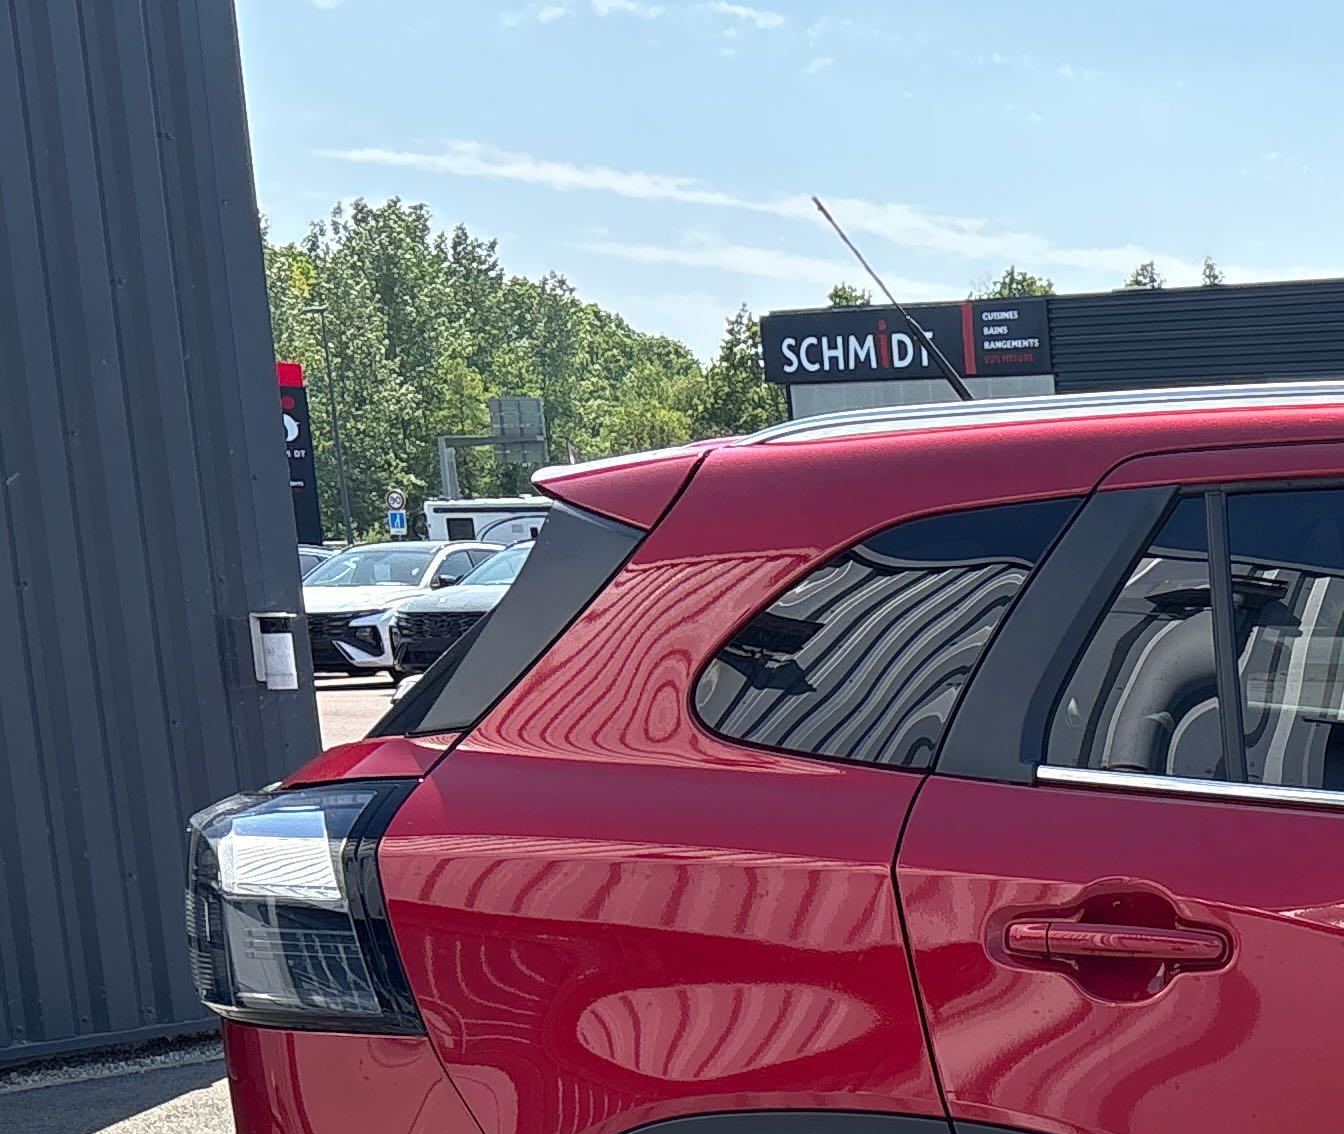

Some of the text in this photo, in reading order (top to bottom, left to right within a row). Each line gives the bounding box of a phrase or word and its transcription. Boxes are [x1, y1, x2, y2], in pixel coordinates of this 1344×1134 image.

[982, 310, 1019, 321] CUISINES
[983, 325, 1008, 335] BAINS
[983, 338, 1040, 350] RANGEMENTS
